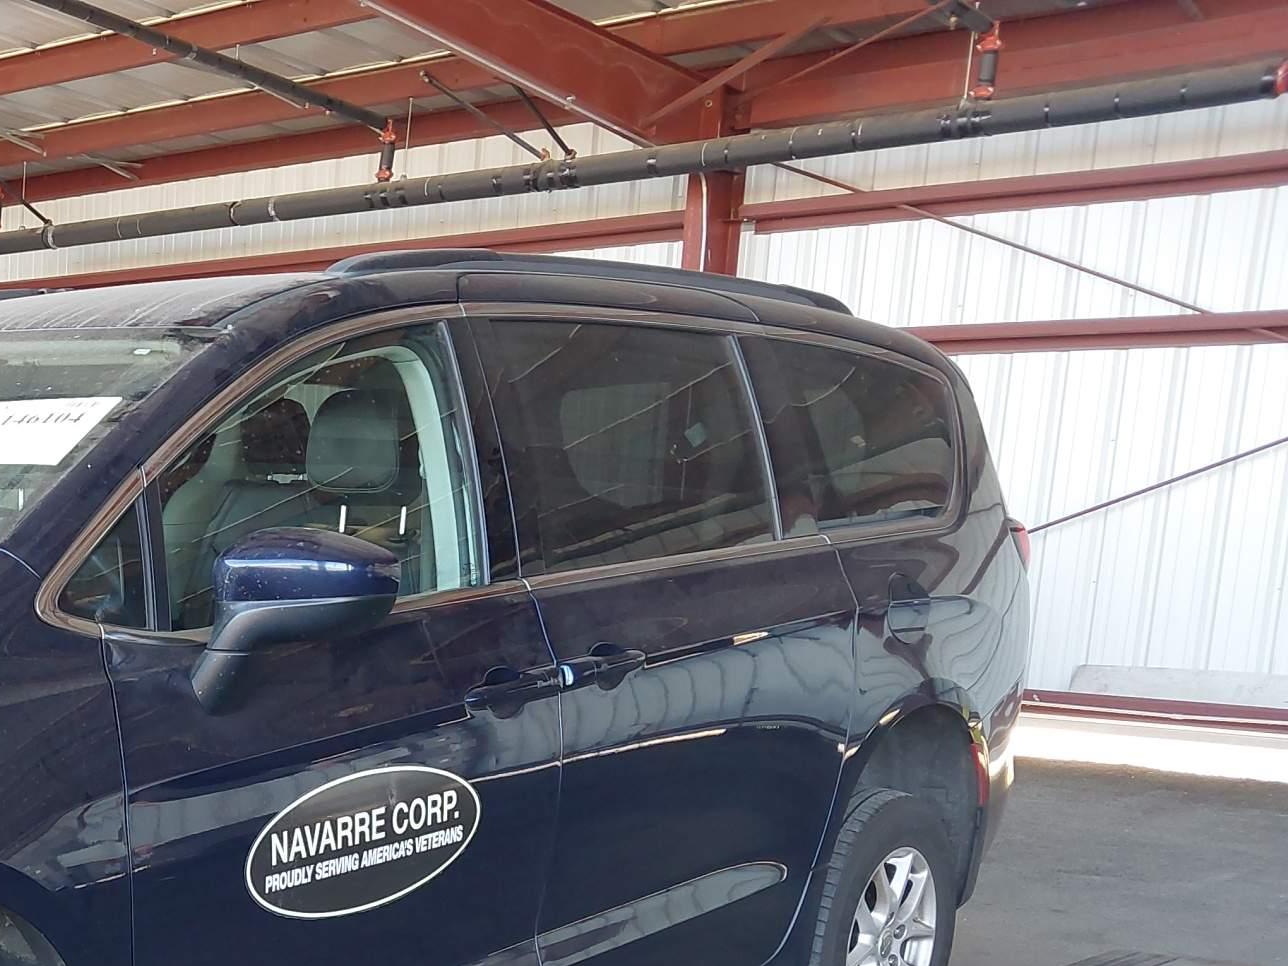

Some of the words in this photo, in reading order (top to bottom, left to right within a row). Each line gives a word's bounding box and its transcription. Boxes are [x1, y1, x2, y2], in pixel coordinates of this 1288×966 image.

[264, 864, 315, 894] PROUDLY
[315, 852, 359, 880] SERVING
[360, 840, 414, 870] AMERICA'S
[414, 825, 464, 853] VETERANS
[271, 807, 386, 866] NAVARRE
[392, 790, 460, 834] CORP.
